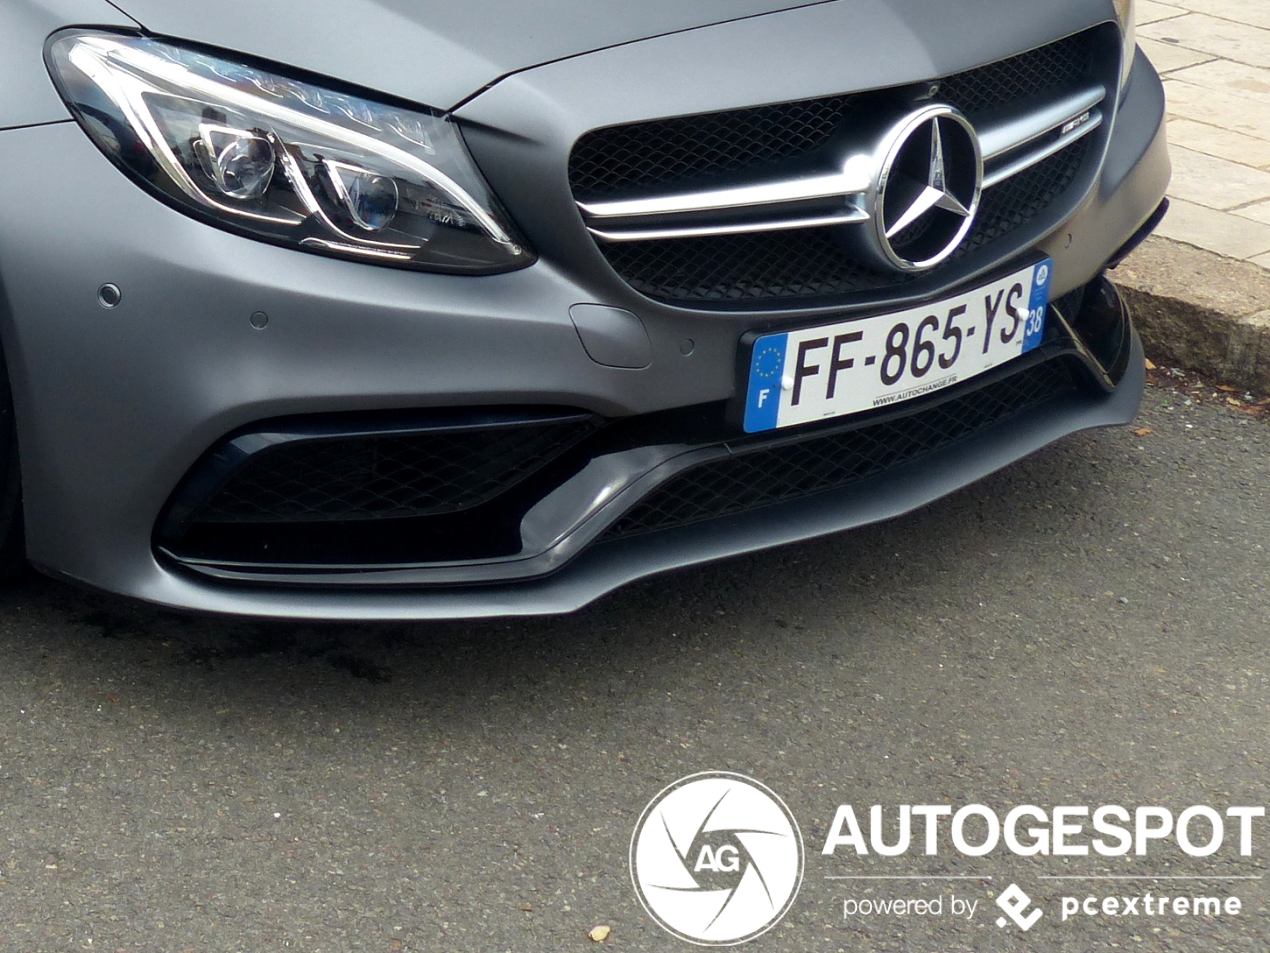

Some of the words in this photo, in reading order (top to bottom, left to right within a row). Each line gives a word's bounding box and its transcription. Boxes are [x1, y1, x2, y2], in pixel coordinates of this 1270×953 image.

[756, 388, 771, 409] F
[790, 282, 1024, 407] FF-865-YS
[1026, 305, 1044, 337] 38
[872, 375, 958, 407] WWW.AUTOCHANGE.FR
